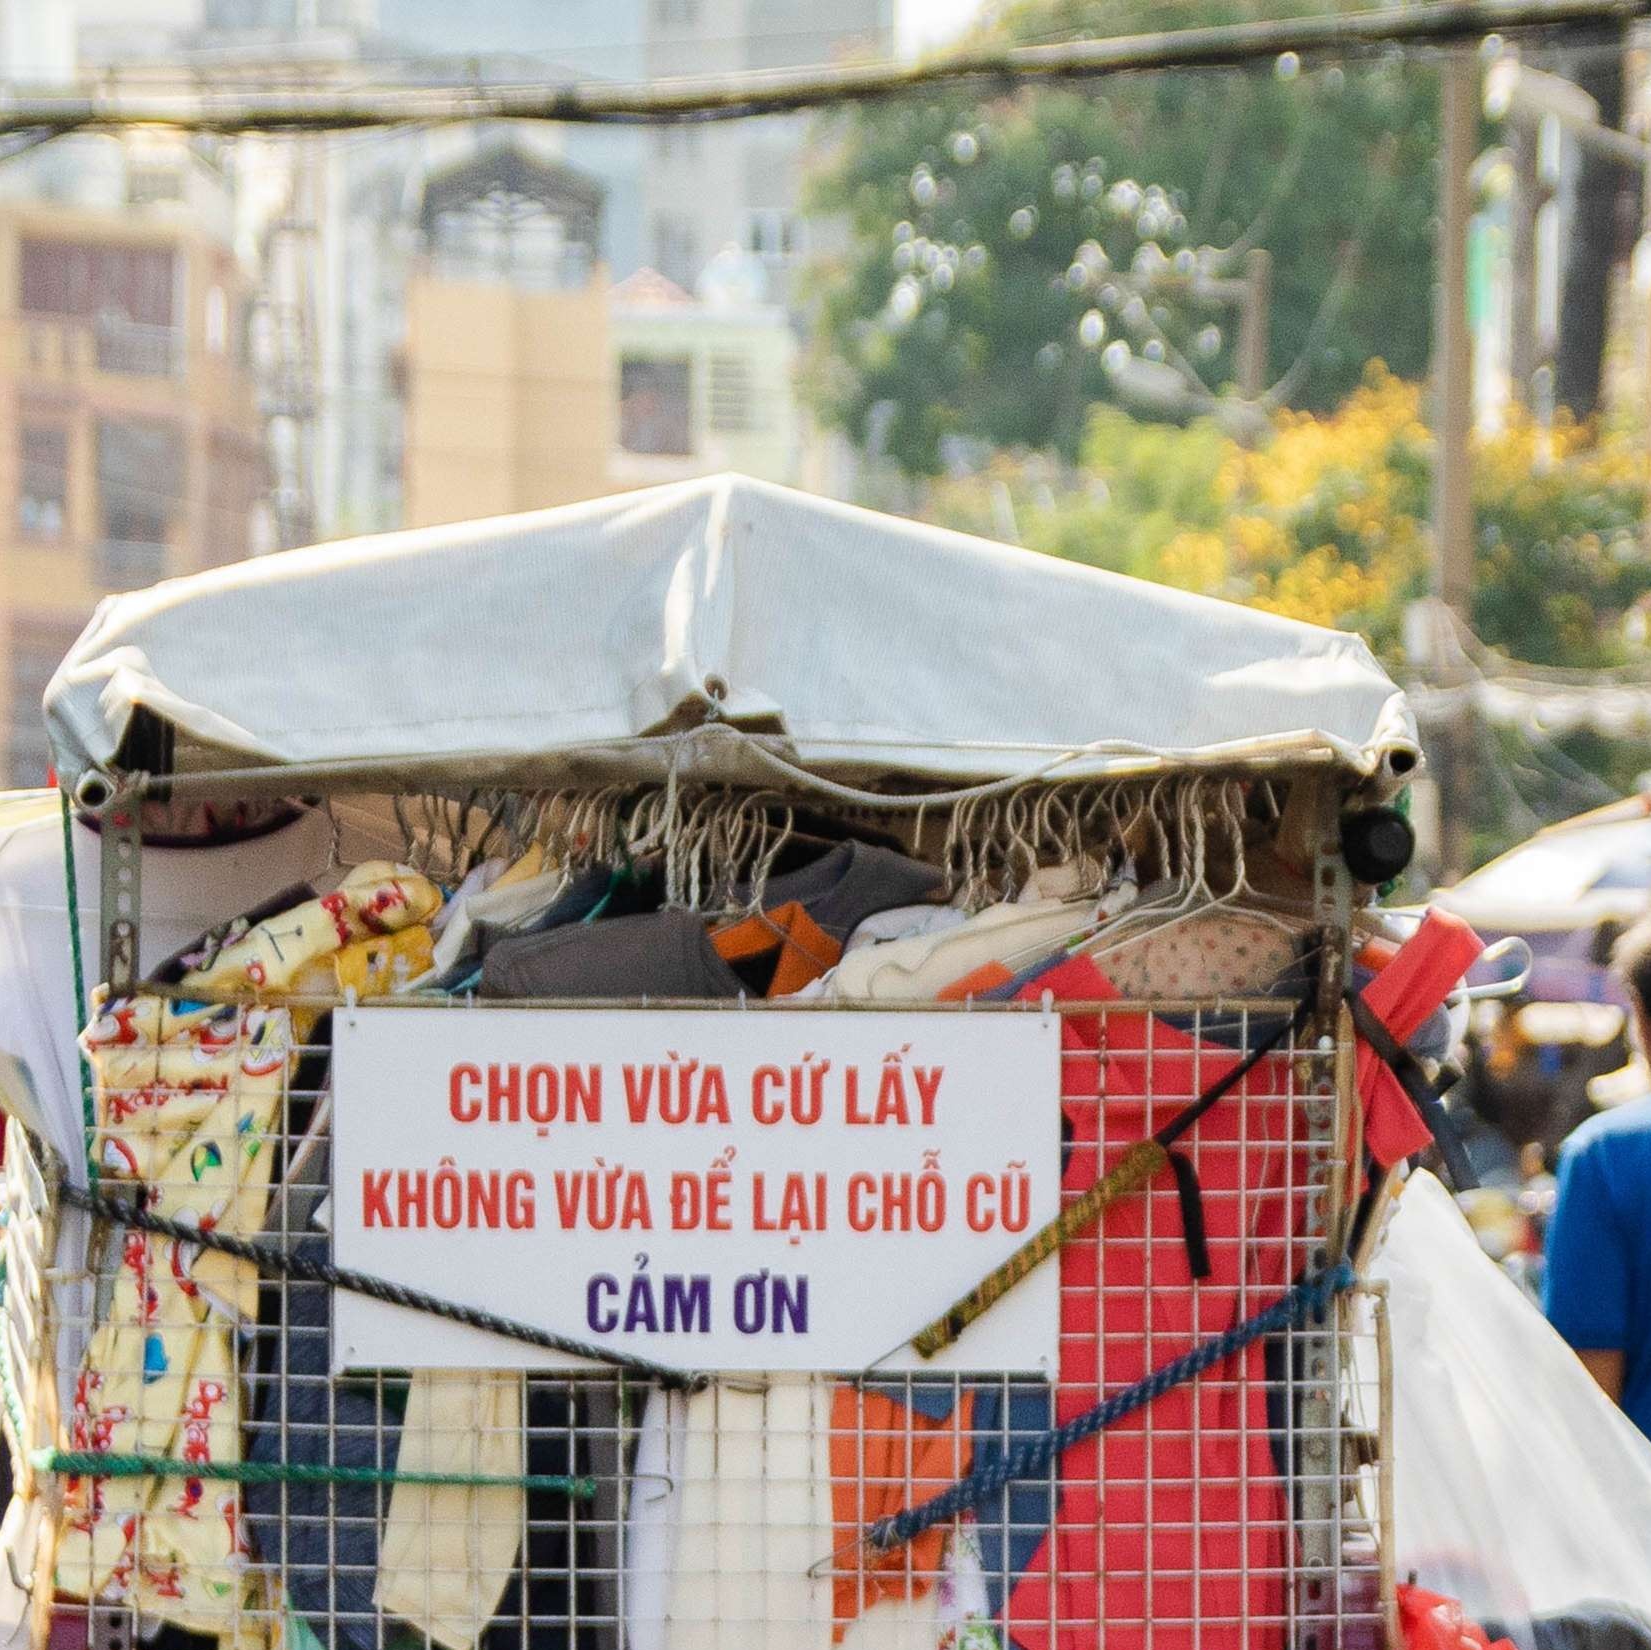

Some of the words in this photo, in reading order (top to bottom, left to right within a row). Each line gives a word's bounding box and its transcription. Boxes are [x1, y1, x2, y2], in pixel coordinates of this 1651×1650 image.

[449, 1061, 602, 1137] CHỌN
[622, 1050, 732, 1126] VỪA
[751, 1051, 831, 1126] CỨ
[844, 1042, 946, 1126] LẤY
[362, 1154, 536, 1231] KHÔNG
[553, 1157, 652, 1232] VỪA
[668, 1145, 738, 1232] ĐỂ
[752, 1170, 828, 1245] LẠI
[847, 1148, 947, 1233] CHỖ
[965, 1161, 1032, 1234] CŨ
[586, 1251, 712, 1334] CẢM
[733, 1268, 810, 1334] ƠN
